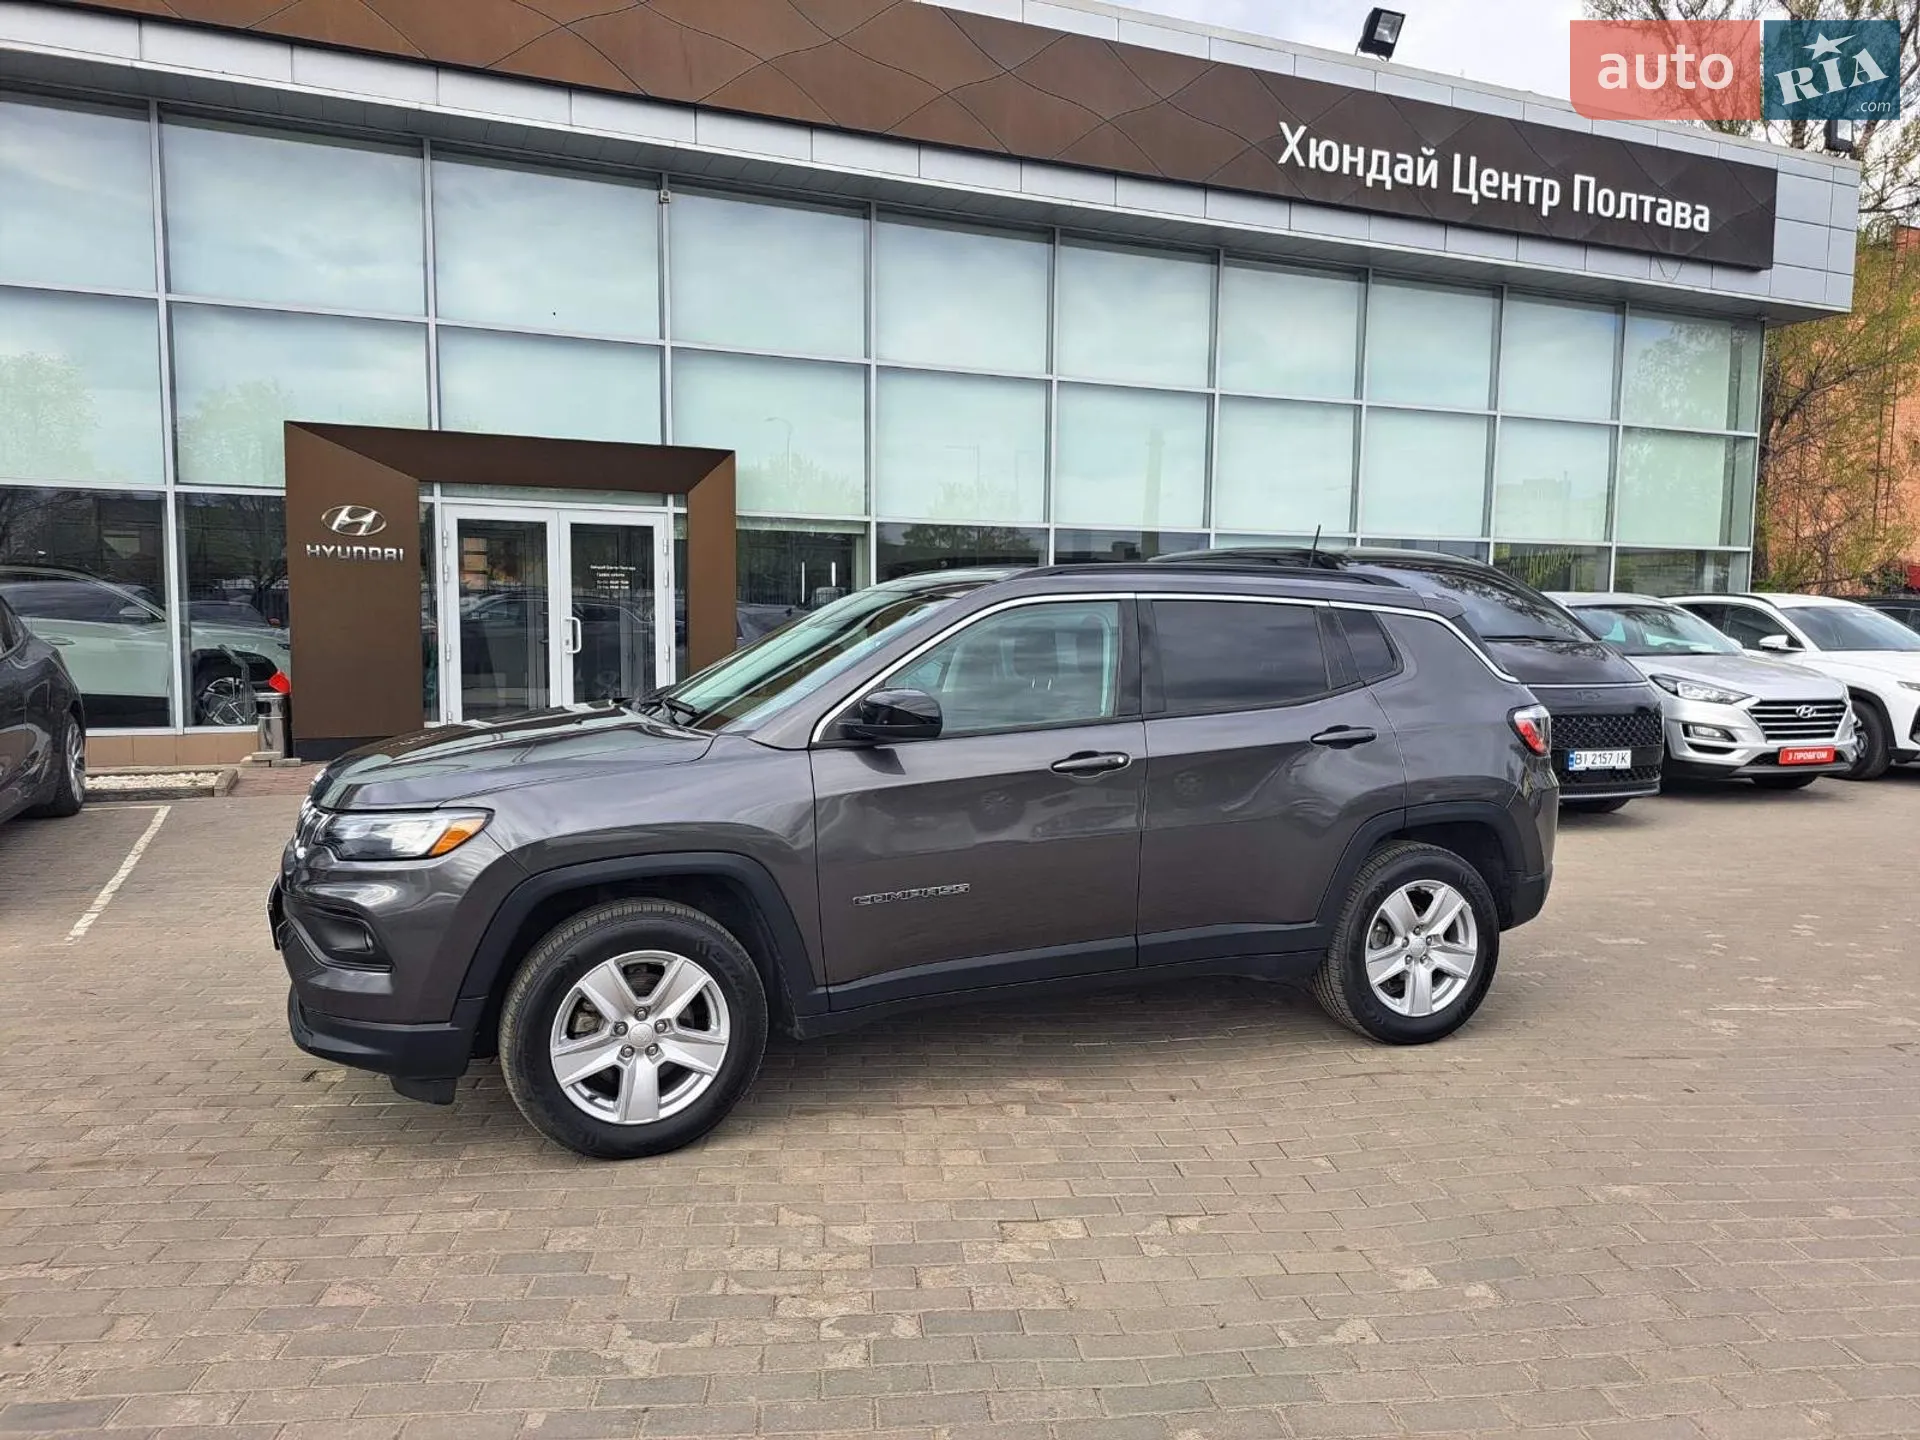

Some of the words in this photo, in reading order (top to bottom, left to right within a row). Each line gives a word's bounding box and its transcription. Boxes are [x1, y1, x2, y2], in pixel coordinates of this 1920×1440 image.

[1277, 121, 1438, 189] Хюндай
[1452, 153, 1561, 216] Центр
[1573, 174, 1710, 232] Полтава
[306, 544, 404, 561] HYUNDAI
[1574, 753, 1588, 765] BI
[1591, 752, 1614, 765] 2157
[1616, 752, 1629, 764] IK
[852, 883, 971, 906] COMPASS
